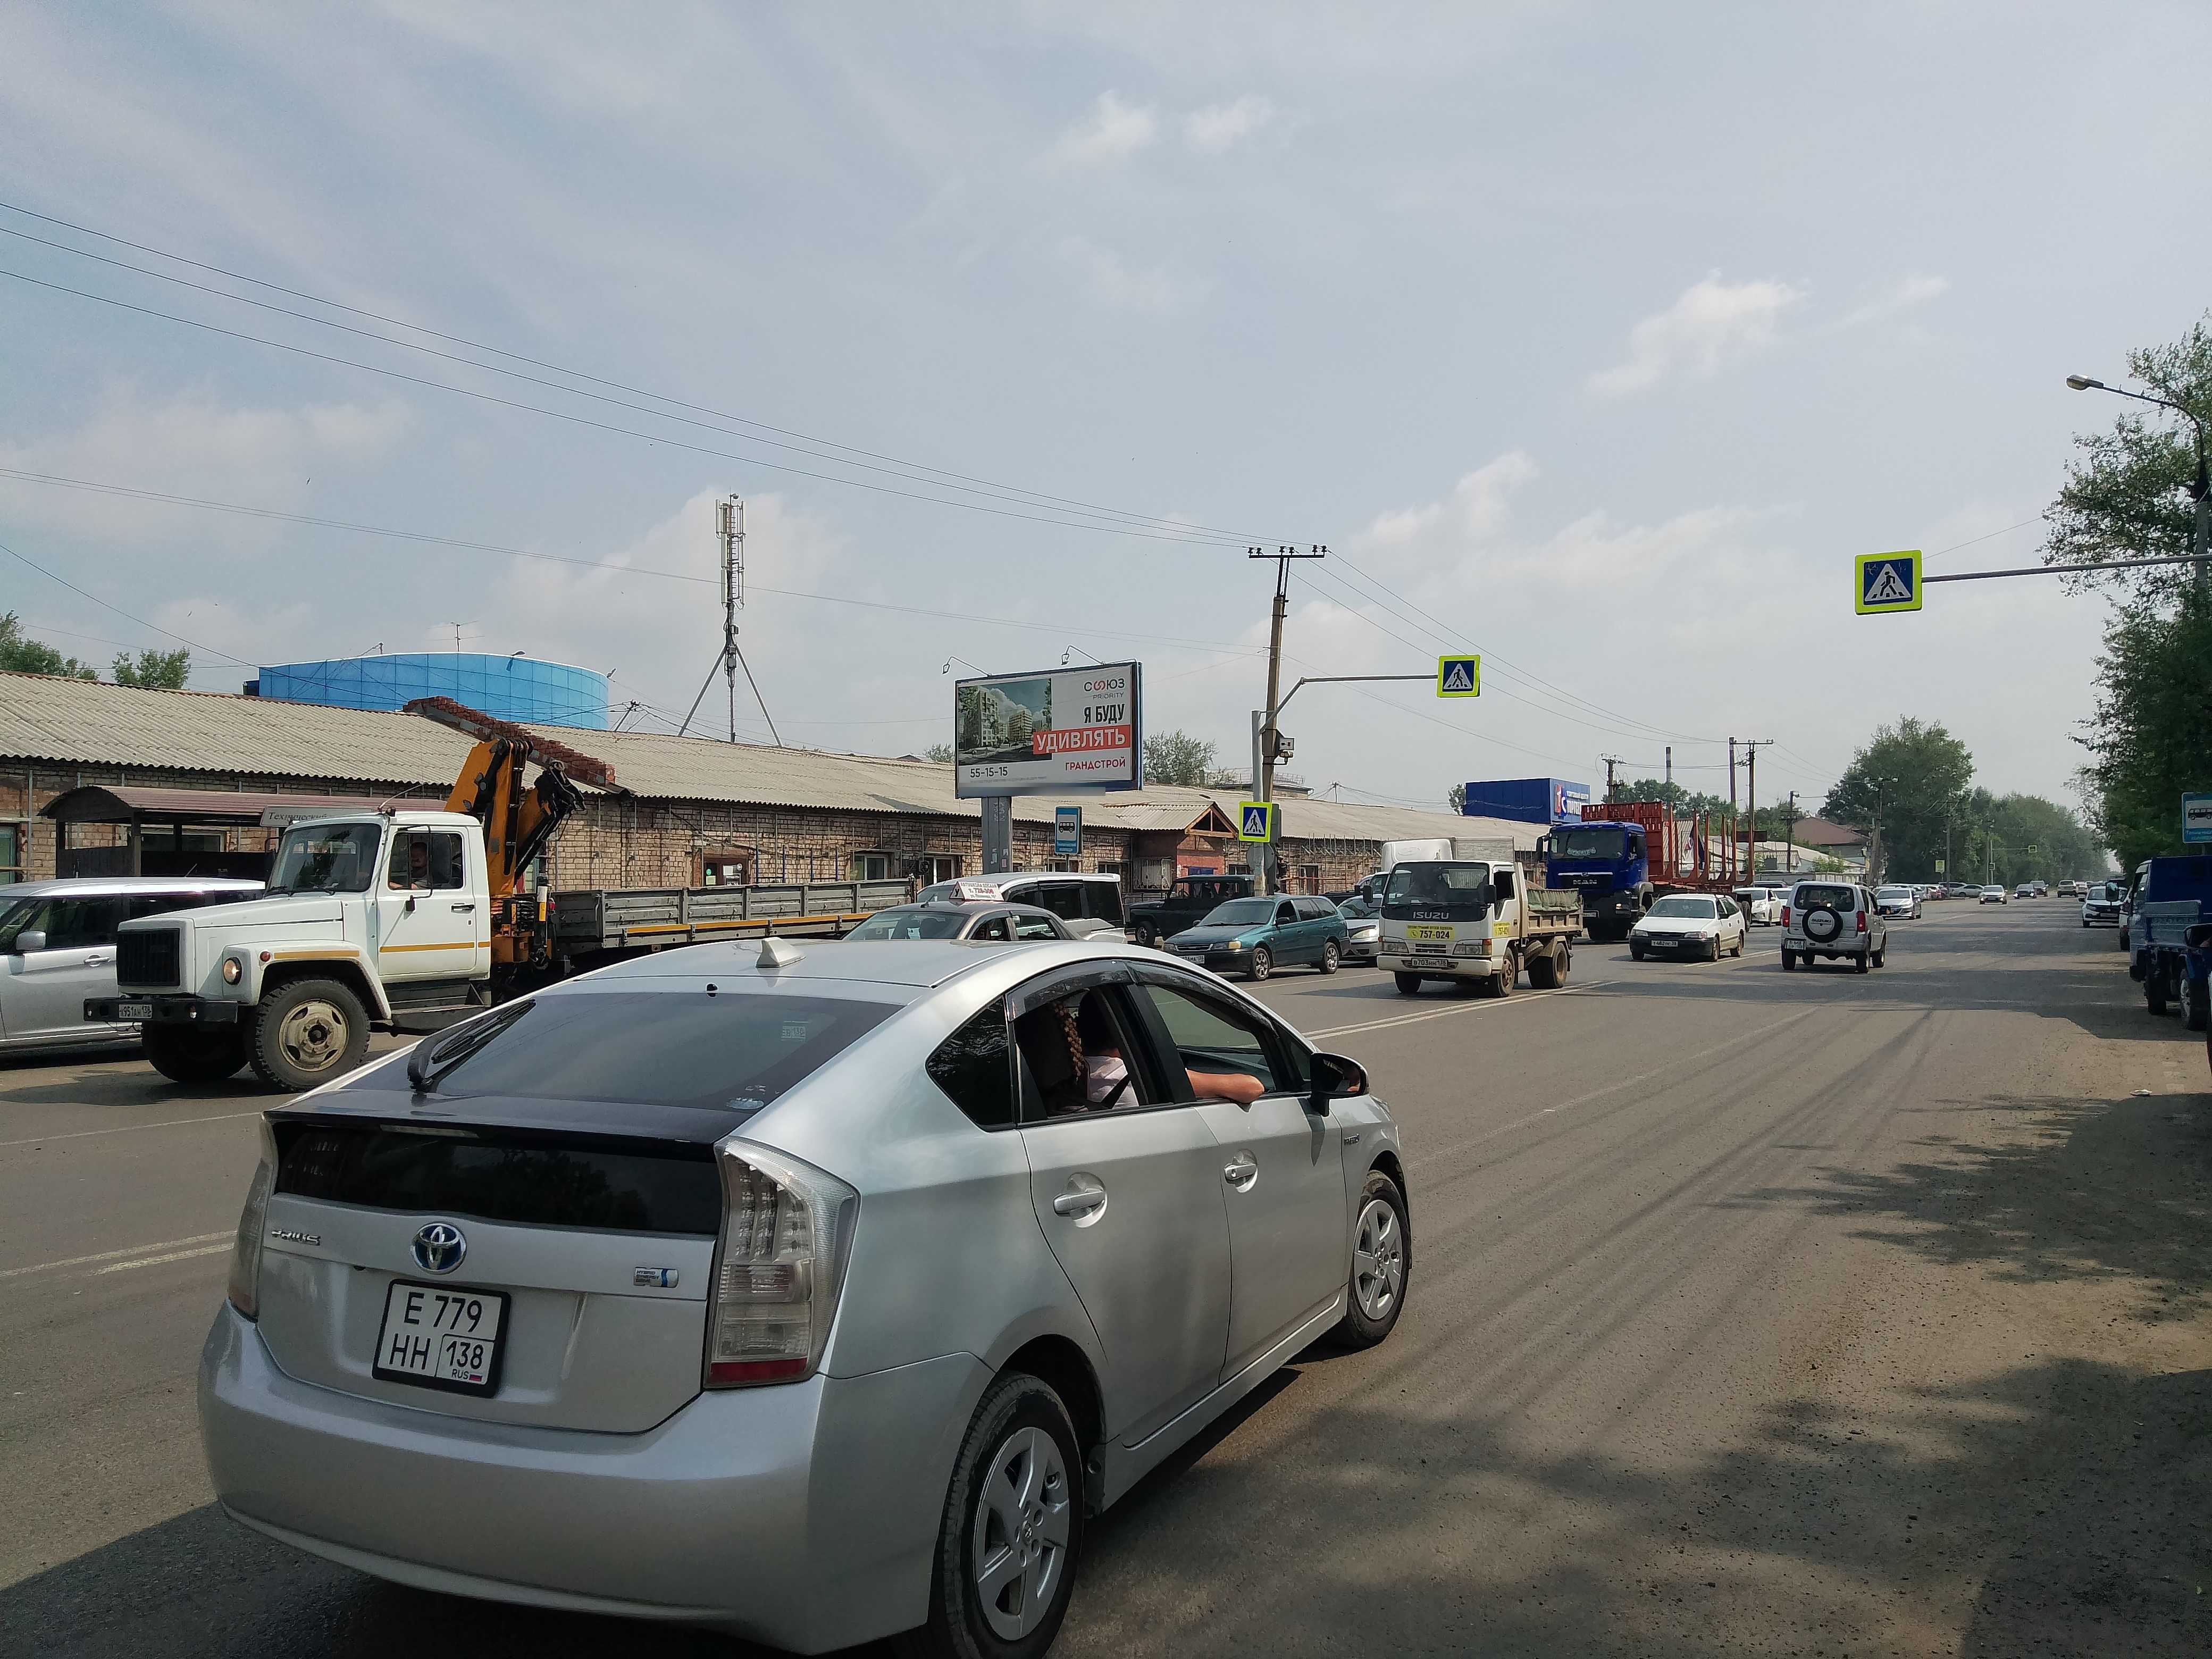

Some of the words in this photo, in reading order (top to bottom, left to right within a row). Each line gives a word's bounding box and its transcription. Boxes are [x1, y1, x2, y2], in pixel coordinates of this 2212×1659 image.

[1084, 707, 1092, 723] Я
[1095, 703, 1125, 724] БУДУ
[1036, 728, 1126, 753] УДИВЛЯТЬ
[1065, 756, 1126, 770] ГРАНДСТРОЙ
[970, 766, 1008, 778] 55-15-15
[1413, 911, 1449, 919] ISUZU
[1419, 930, 1450, 939] 757-024
[433, 1294, 482, 1333] 779
[446, 1340, 484, 1370] 138
[452, 1369, 469, 1380] RUS
